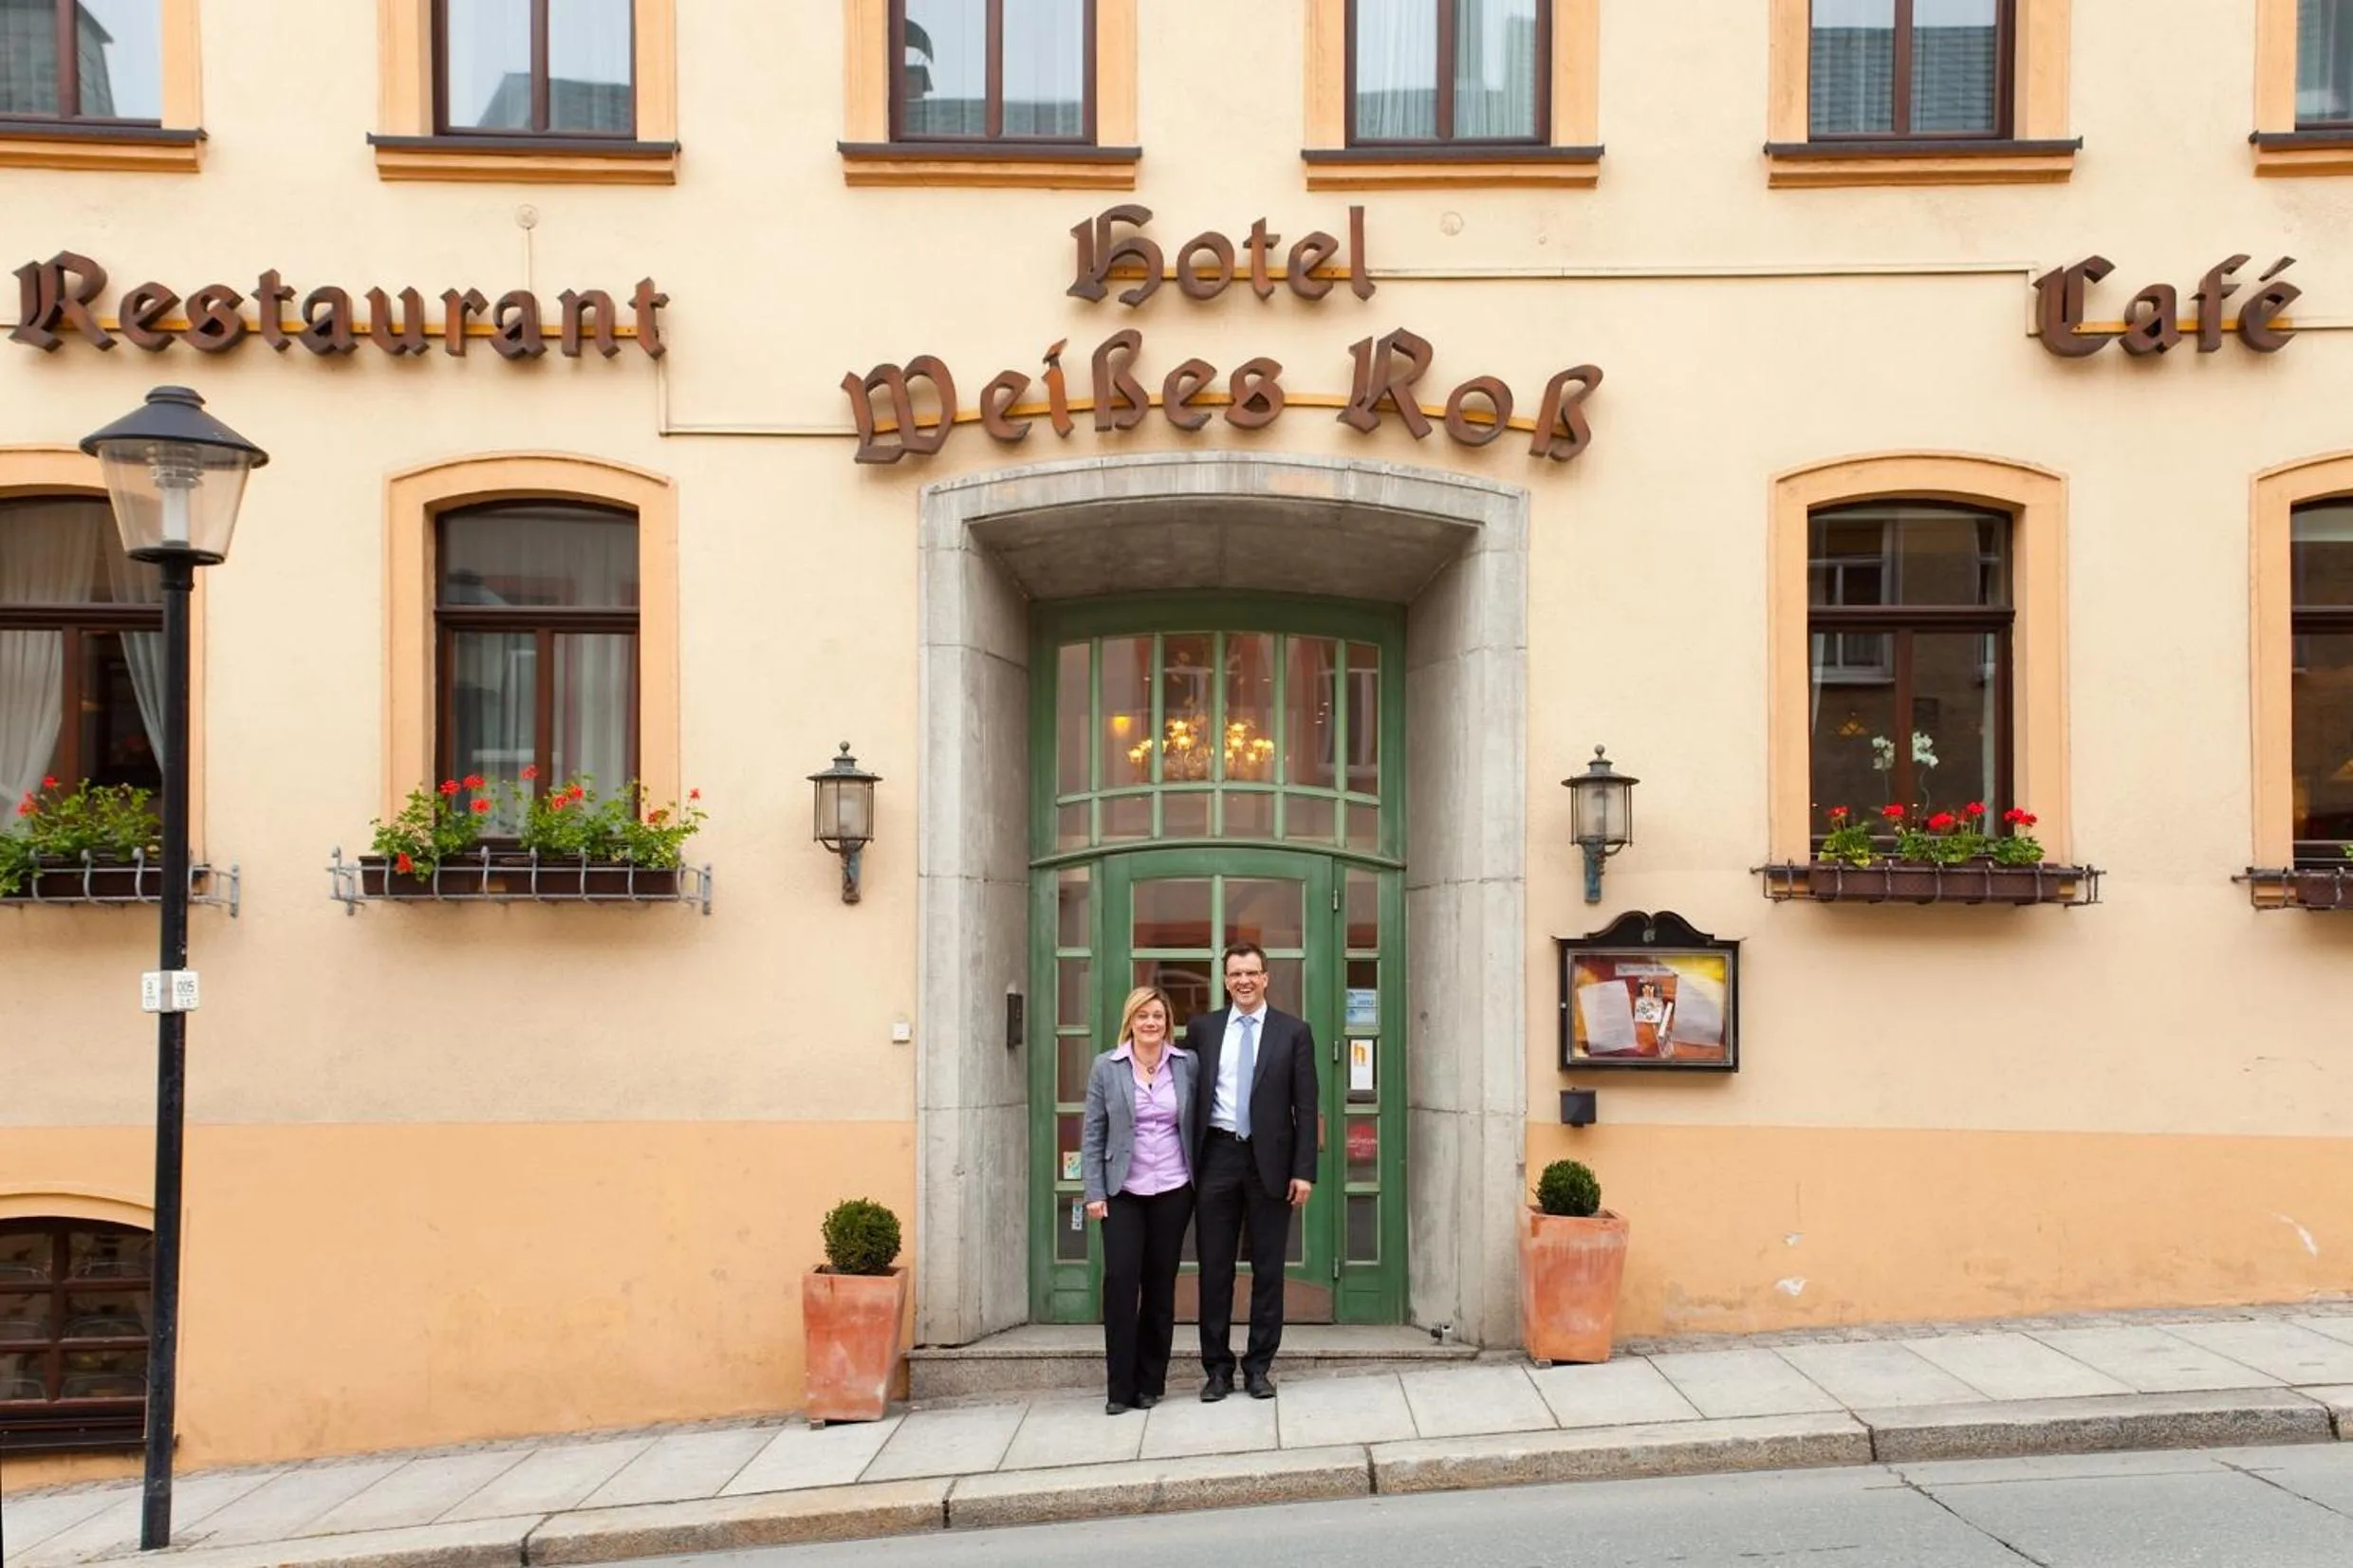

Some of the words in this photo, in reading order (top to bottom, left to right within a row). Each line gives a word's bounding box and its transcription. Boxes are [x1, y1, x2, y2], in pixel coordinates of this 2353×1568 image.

[9, 249, 670, 361] Restaurant
[1066, 204, 1376, 308] Hotel
[2032, 253, 2303, 358] Café
[841, 328, 1285, 465] Weißes
[1336, 327, 1604, 463] Roß
